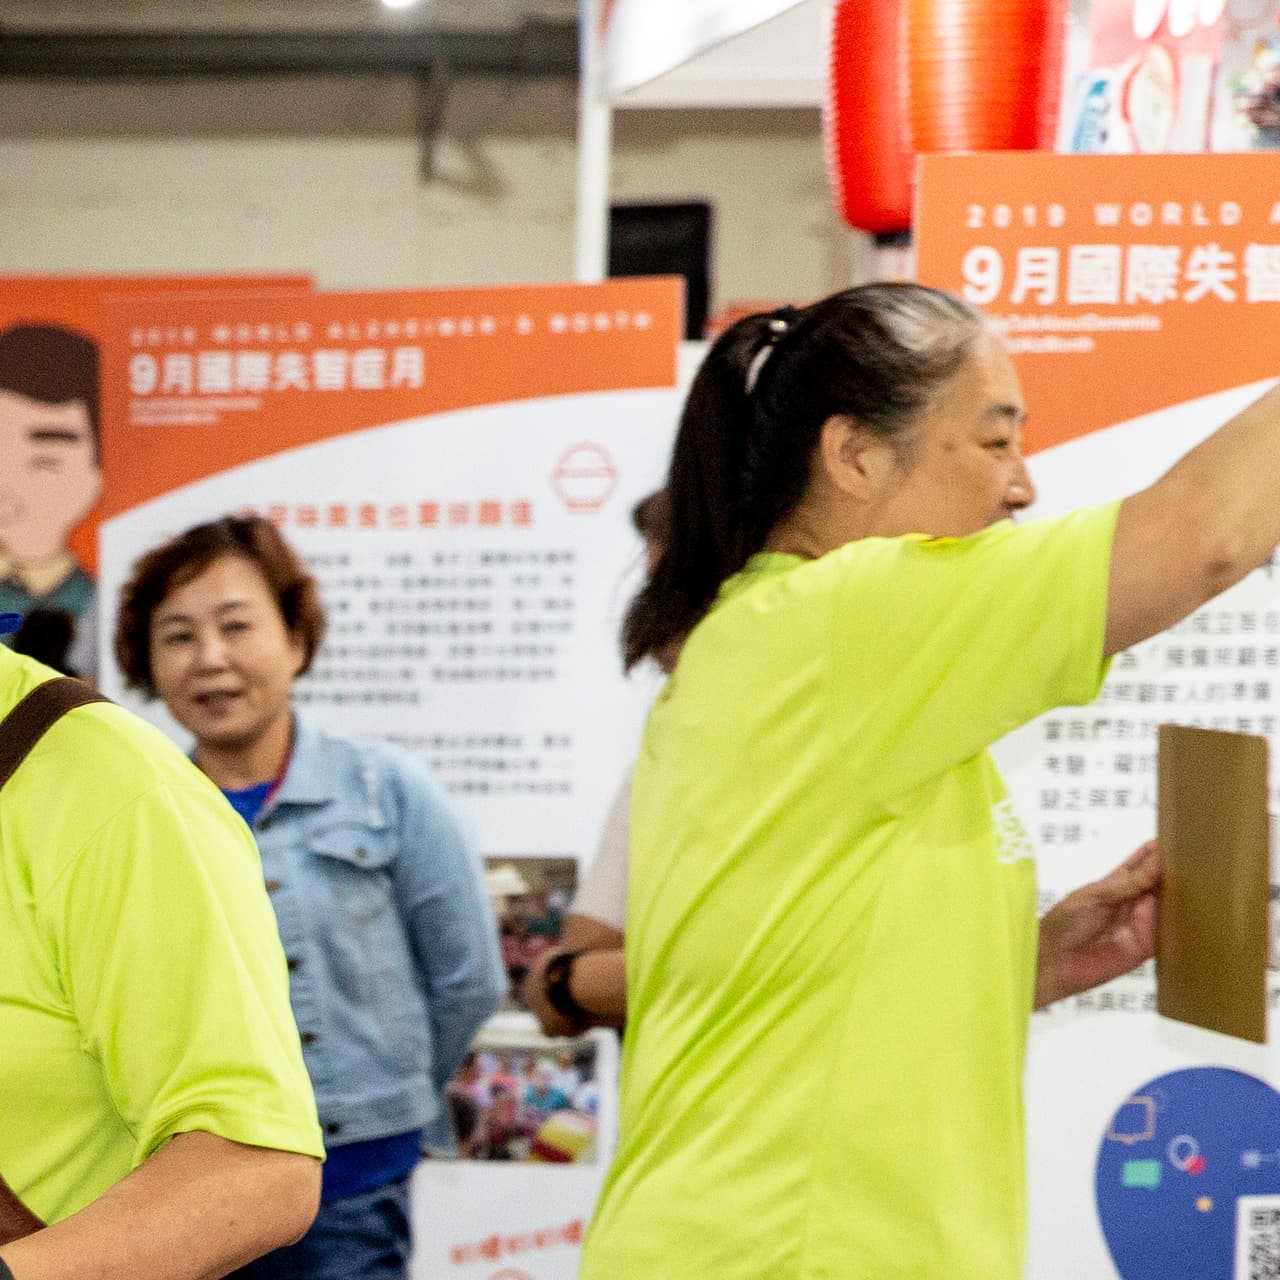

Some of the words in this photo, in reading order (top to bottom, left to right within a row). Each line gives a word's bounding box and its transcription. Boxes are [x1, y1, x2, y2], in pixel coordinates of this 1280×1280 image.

[966, 203, 1066, 229] 2019
[1093, 201, 1242, 227] WORLD
[129, 346, 425, 394] 9月國際失智症月
